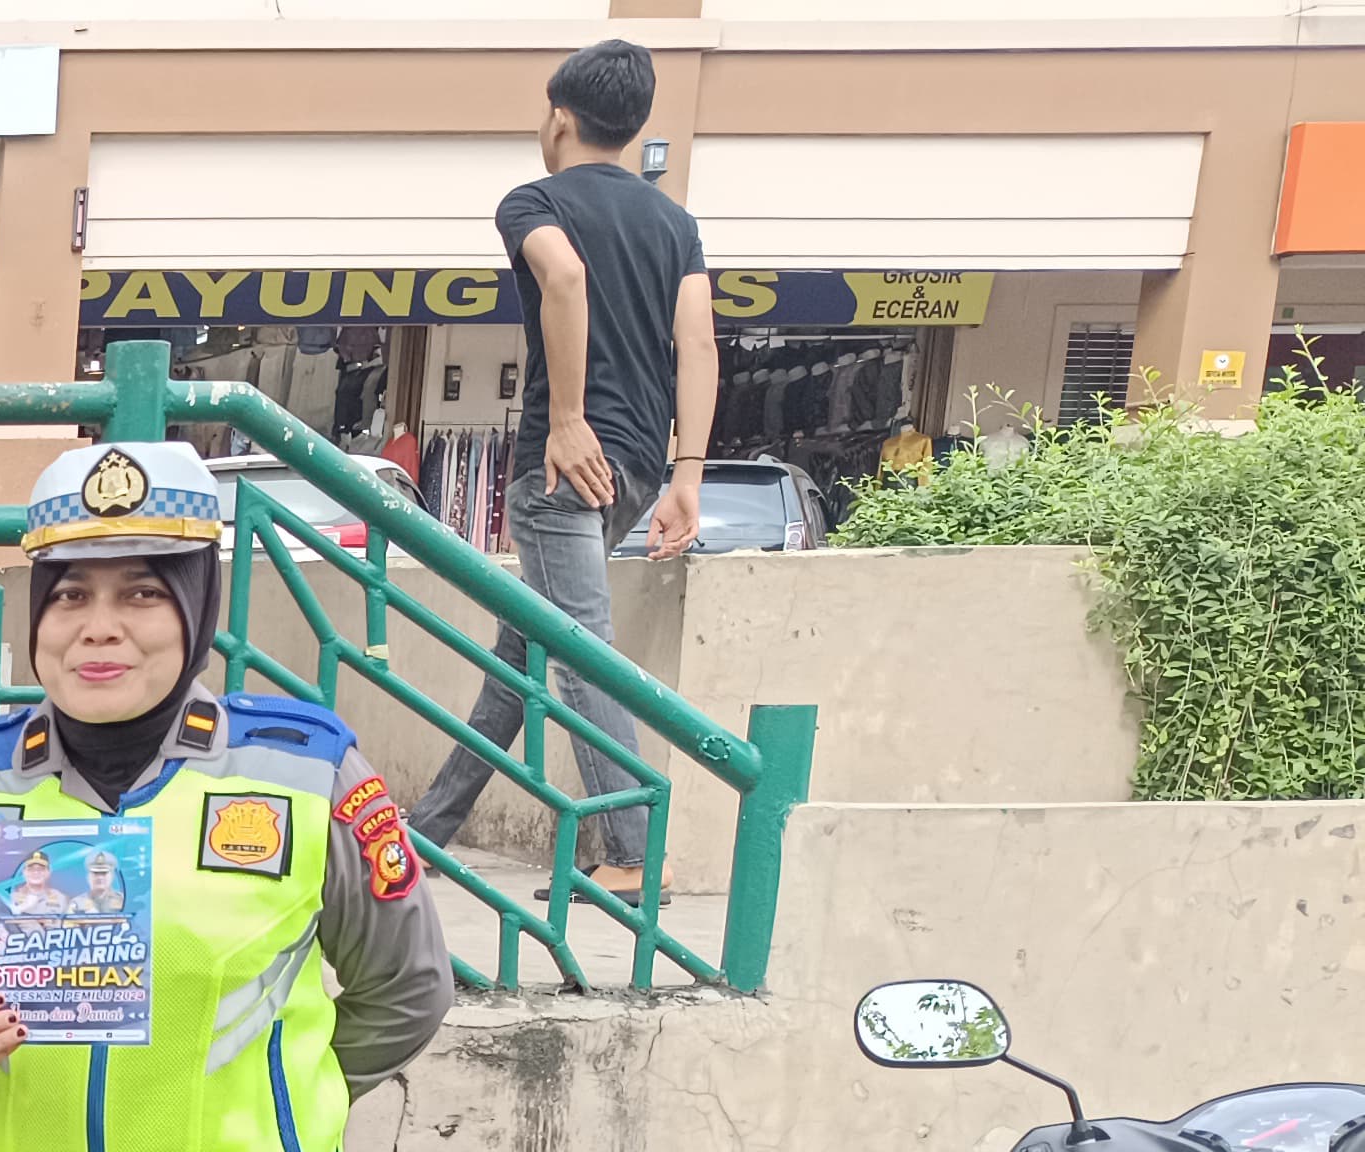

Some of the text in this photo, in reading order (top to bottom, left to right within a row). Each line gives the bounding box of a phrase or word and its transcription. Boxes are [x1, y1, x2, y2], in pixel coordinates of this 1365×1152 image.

[872, 300, 959, 319] ECERAN
[362, 807, 394, 836] RIAU
[6, 925, 114, 954] SARING
[48, 943, 146, 967] SHARING
[56, 966, 143, 987] HOAX
[63, 990, 114, 1002] PEMILU
[113, 990, 146, 1001] 2024
[49, 1006, 76, 1022] dan
[76, 1001, 125, 1023] Damai
